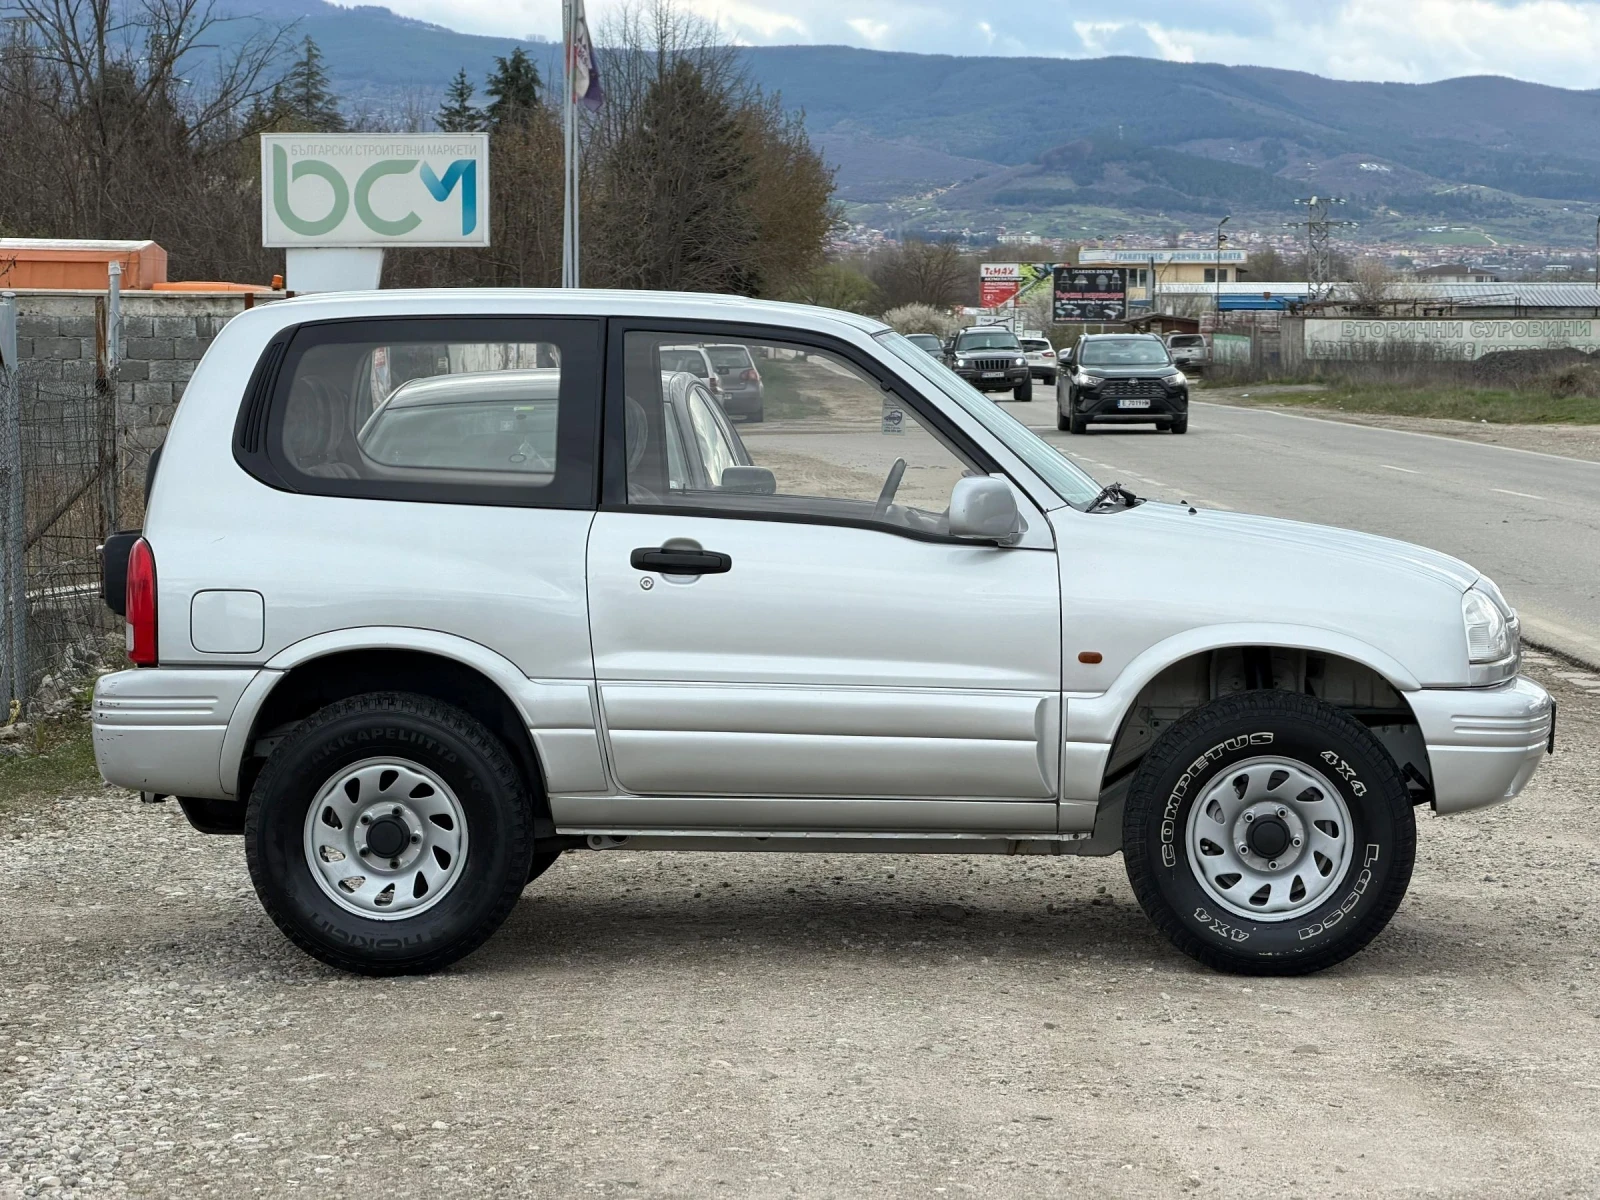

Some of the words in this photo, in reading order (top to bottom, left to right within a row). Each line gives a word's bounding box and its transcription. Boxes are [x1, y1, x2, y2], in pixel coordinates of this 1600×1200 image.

[291, 144, 353, 156] БЪЛГАРСКИ
[355, 144, 425, 156] СТРОИТЕЛНИ
[428, 144, 477, 156] МАРКЕТИ
[1341, 321, 1464, 338] ВТОРИЧНИ
[1469, 320, 1591, 338] СУРОВИНИ
[1160, 731, 1274, 868] COMPETUS
